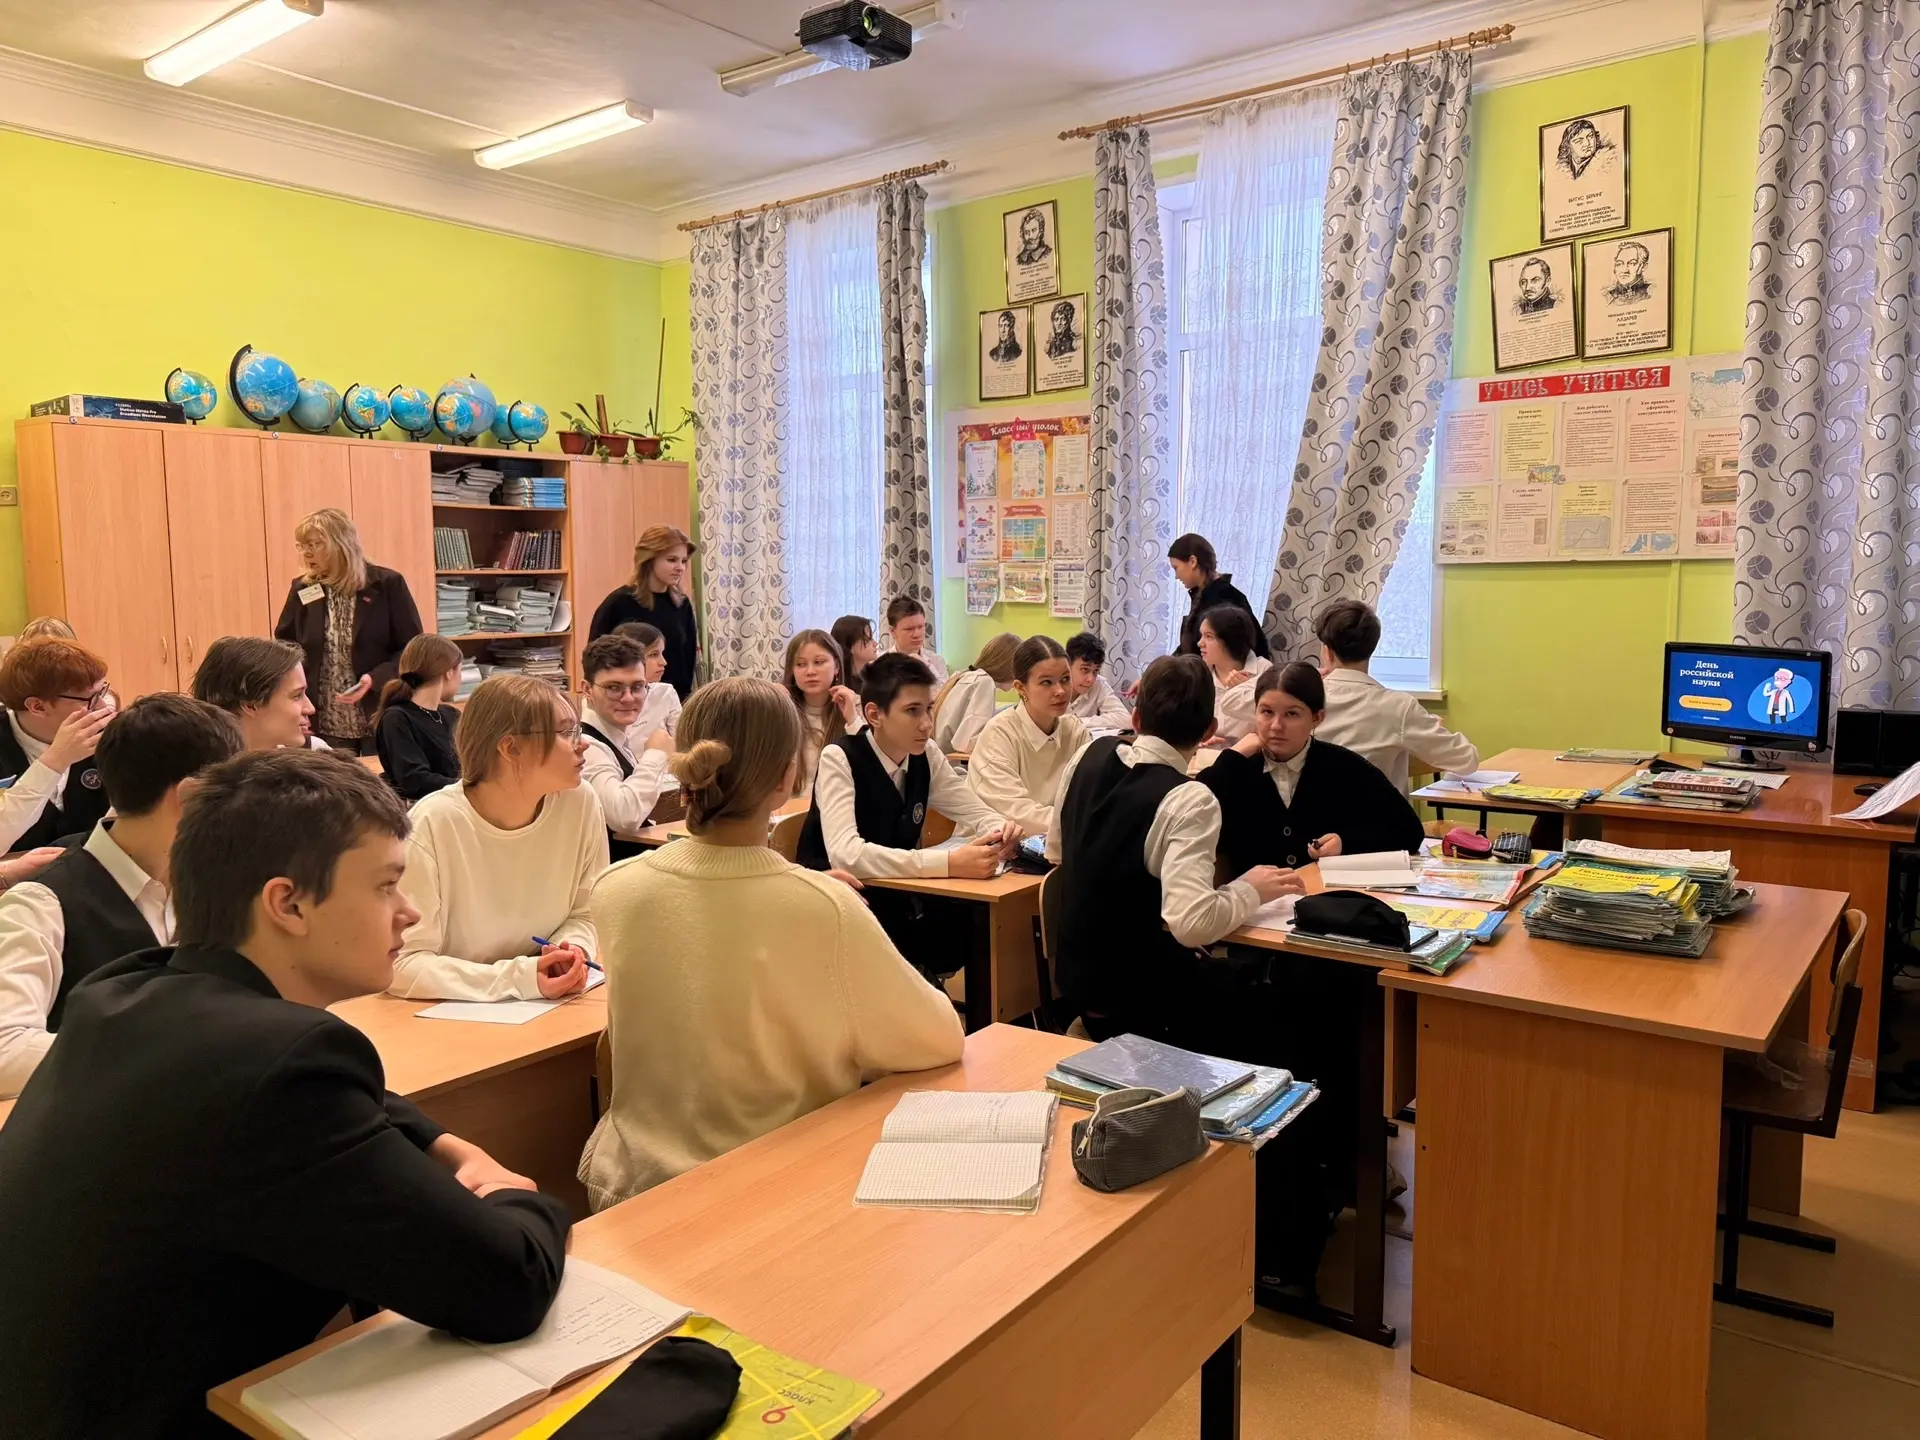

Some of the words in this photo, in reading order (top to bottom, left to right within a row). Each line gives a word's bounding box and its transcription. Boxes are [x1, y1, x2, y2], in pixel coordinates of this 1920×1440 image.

[1484, 379, 1548, 400] УЧИСЬ
[1563, 368, 1663, 393] УЧИТЬСЯ
[1032, 424, 1060, 433] уголок
[1680, 669, 1734, 679] российской
[1692, 679, 1720, 687] науки
[777, 1388, 815, 1406] класс
